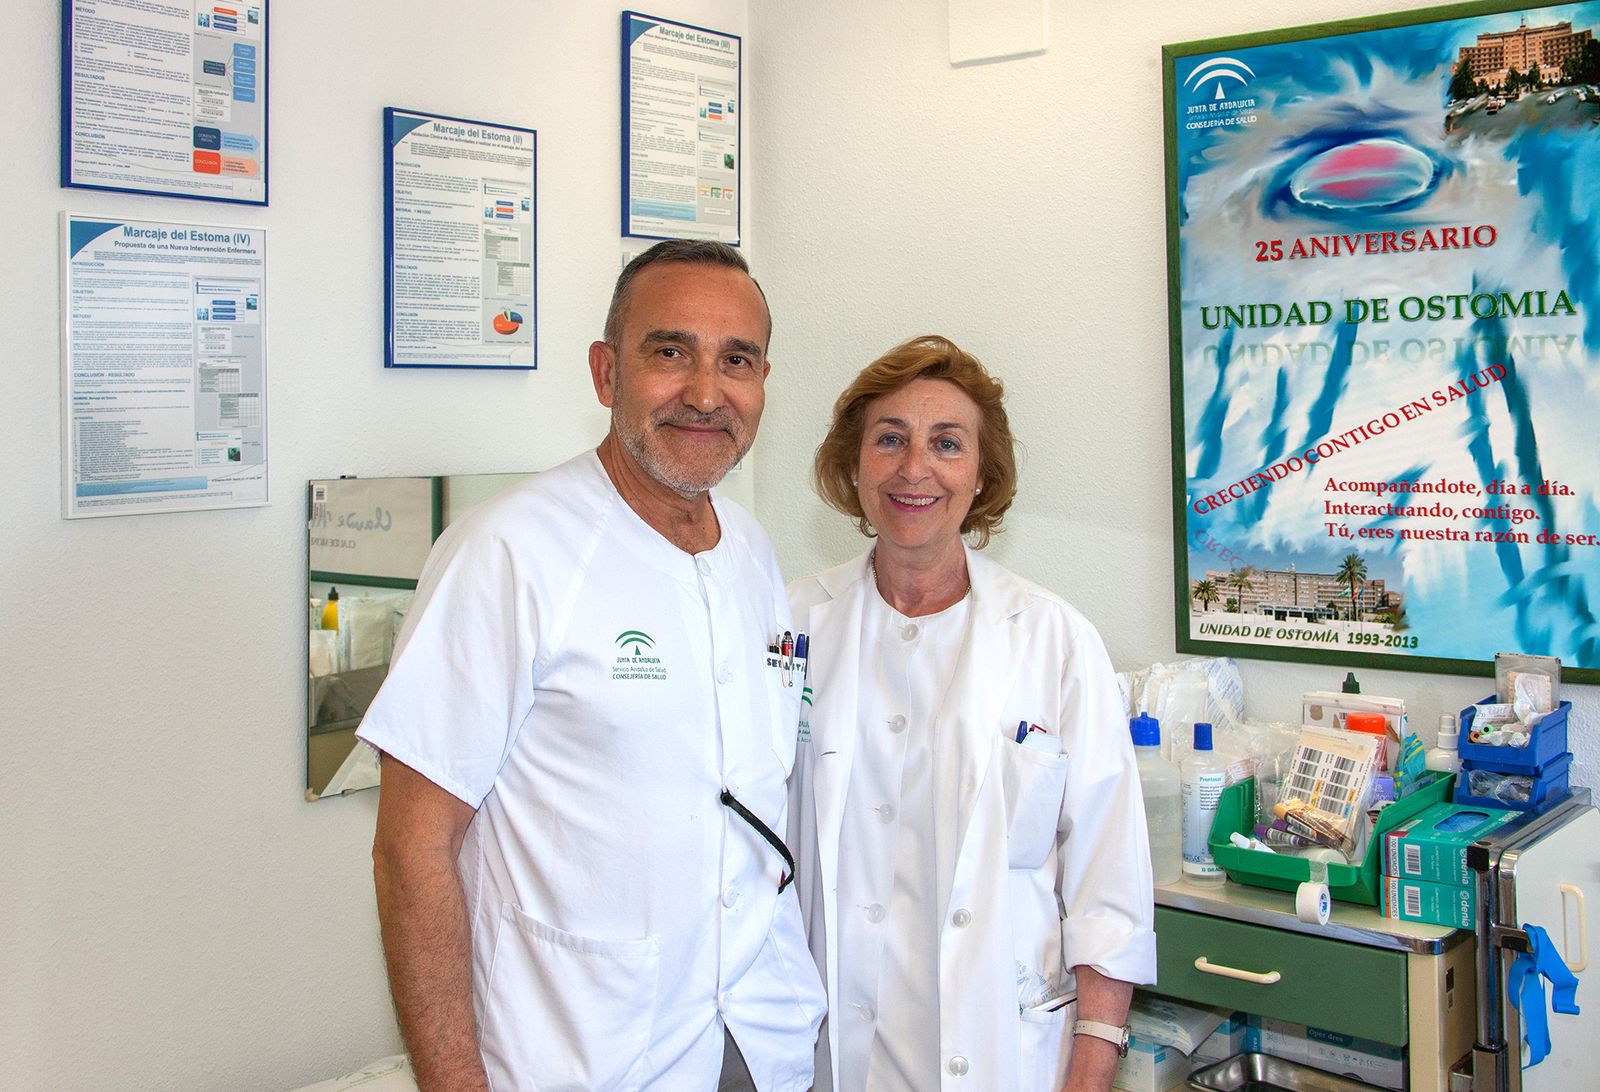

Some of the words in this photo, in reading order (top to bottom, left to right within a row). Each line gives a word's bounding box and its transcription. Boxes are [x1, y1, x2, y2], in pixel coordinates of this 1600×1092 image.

[659, 26, 685, 40] Marcaje
[686, 32, 696, 41] del
[697, 34, 720, 46] Estoma
[1187, 104, 1208, 114] JUNTA
[1209, 103, 1218, 112] DE
[1225, 117, 1235, 126] DE
[1236, 115, 1258, 125] SALUD
[433, 122, 466, 137] Marcaje
[468, 128, 480, 138] del
[481, 129, 511, 143] Estoma
[512, 133, 523, 146] (II)
[114, 240, 147, 250] Propuesta
[189, 245, 227, 254] Intervención
[227, 247, 257, 255] Enfermera
[123, 226, 168, 241] Marcaje
[170, 229, 187, 241] del
[190, 230, 230, 243] Estoma
[233, 233, 251, 246] (IV)
[1255, 240, 1283, 262] 25
[1290, 224, 1497, 259] ANIVERSARIO
[1200, 301, 1333, 330] UNIDAD
[1343, 298, 1389, 324] DE
[1399, 289, 1577, 321] OSTOMIA
[1193, 457, 1303, 515] CRECIENDO
[1303, 411, 1401, 465] CONTIGO
[1399, 396, 1433, 421] EN
[1432, 363, 1508, 407] SALUD
[1324, 477, 1482, 497] Acompañándote,
[1485, 479, 1516, 495] día
[1520, 484, 1531, 495] a
[1537, 480, 1576, 496] día.
[1324, 500, 1458, 521] Interactuando,
[1462, 503, 1541, 525] contigo.
[1324, 522, 1355, 541] Tú,
[1358, 527, 1395, 539] eres
[1400, 527, 1470, 542] nuestra
[1475, 528, 1530, 544] razón
[1536, 528, 1561, 545] de
[1565, 532, 1600, 546] ser.
[1199, 622, 1251, 638] UNIDAD
[1254, 627, 1274, 639] DE
[1276, 628, 1340, 644] OSTOMÍA
[1347, 631, 1419, 649] 1993-2013
[652, 673, 667, 681] SALUD
[1391, 849, 1399, 877] UNIDADES
[1391, 890, 1399, 918] UNIDADES
[1460, 901, 1471, 927] denia
